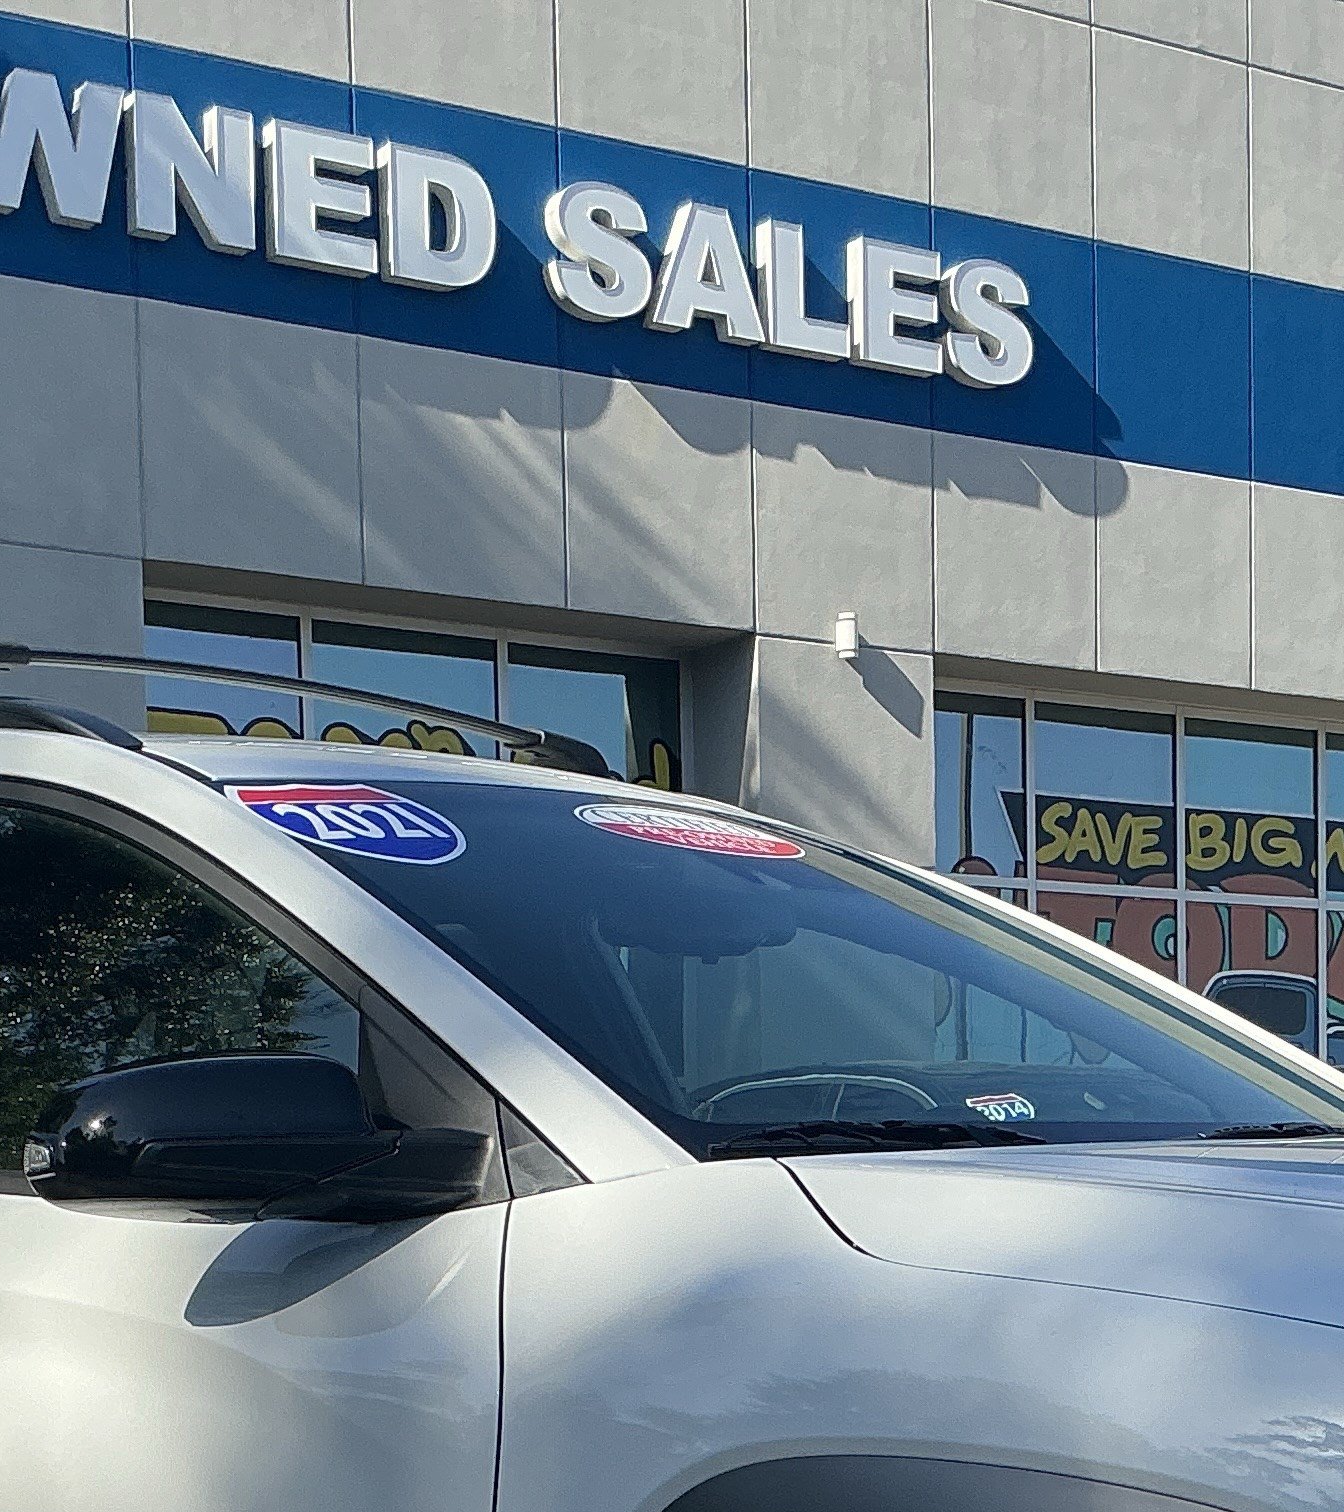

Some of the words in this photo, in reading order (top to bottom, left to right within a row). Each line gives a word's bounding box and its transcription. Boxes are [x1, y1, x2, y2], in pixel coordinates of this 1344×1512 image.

[544, 182, 1034, 389] SALES
[272, 803, 451, 840] 2021
[1036, 802, 1167, 868] SAVE
[1186, 812, 1304, 872] BIG
